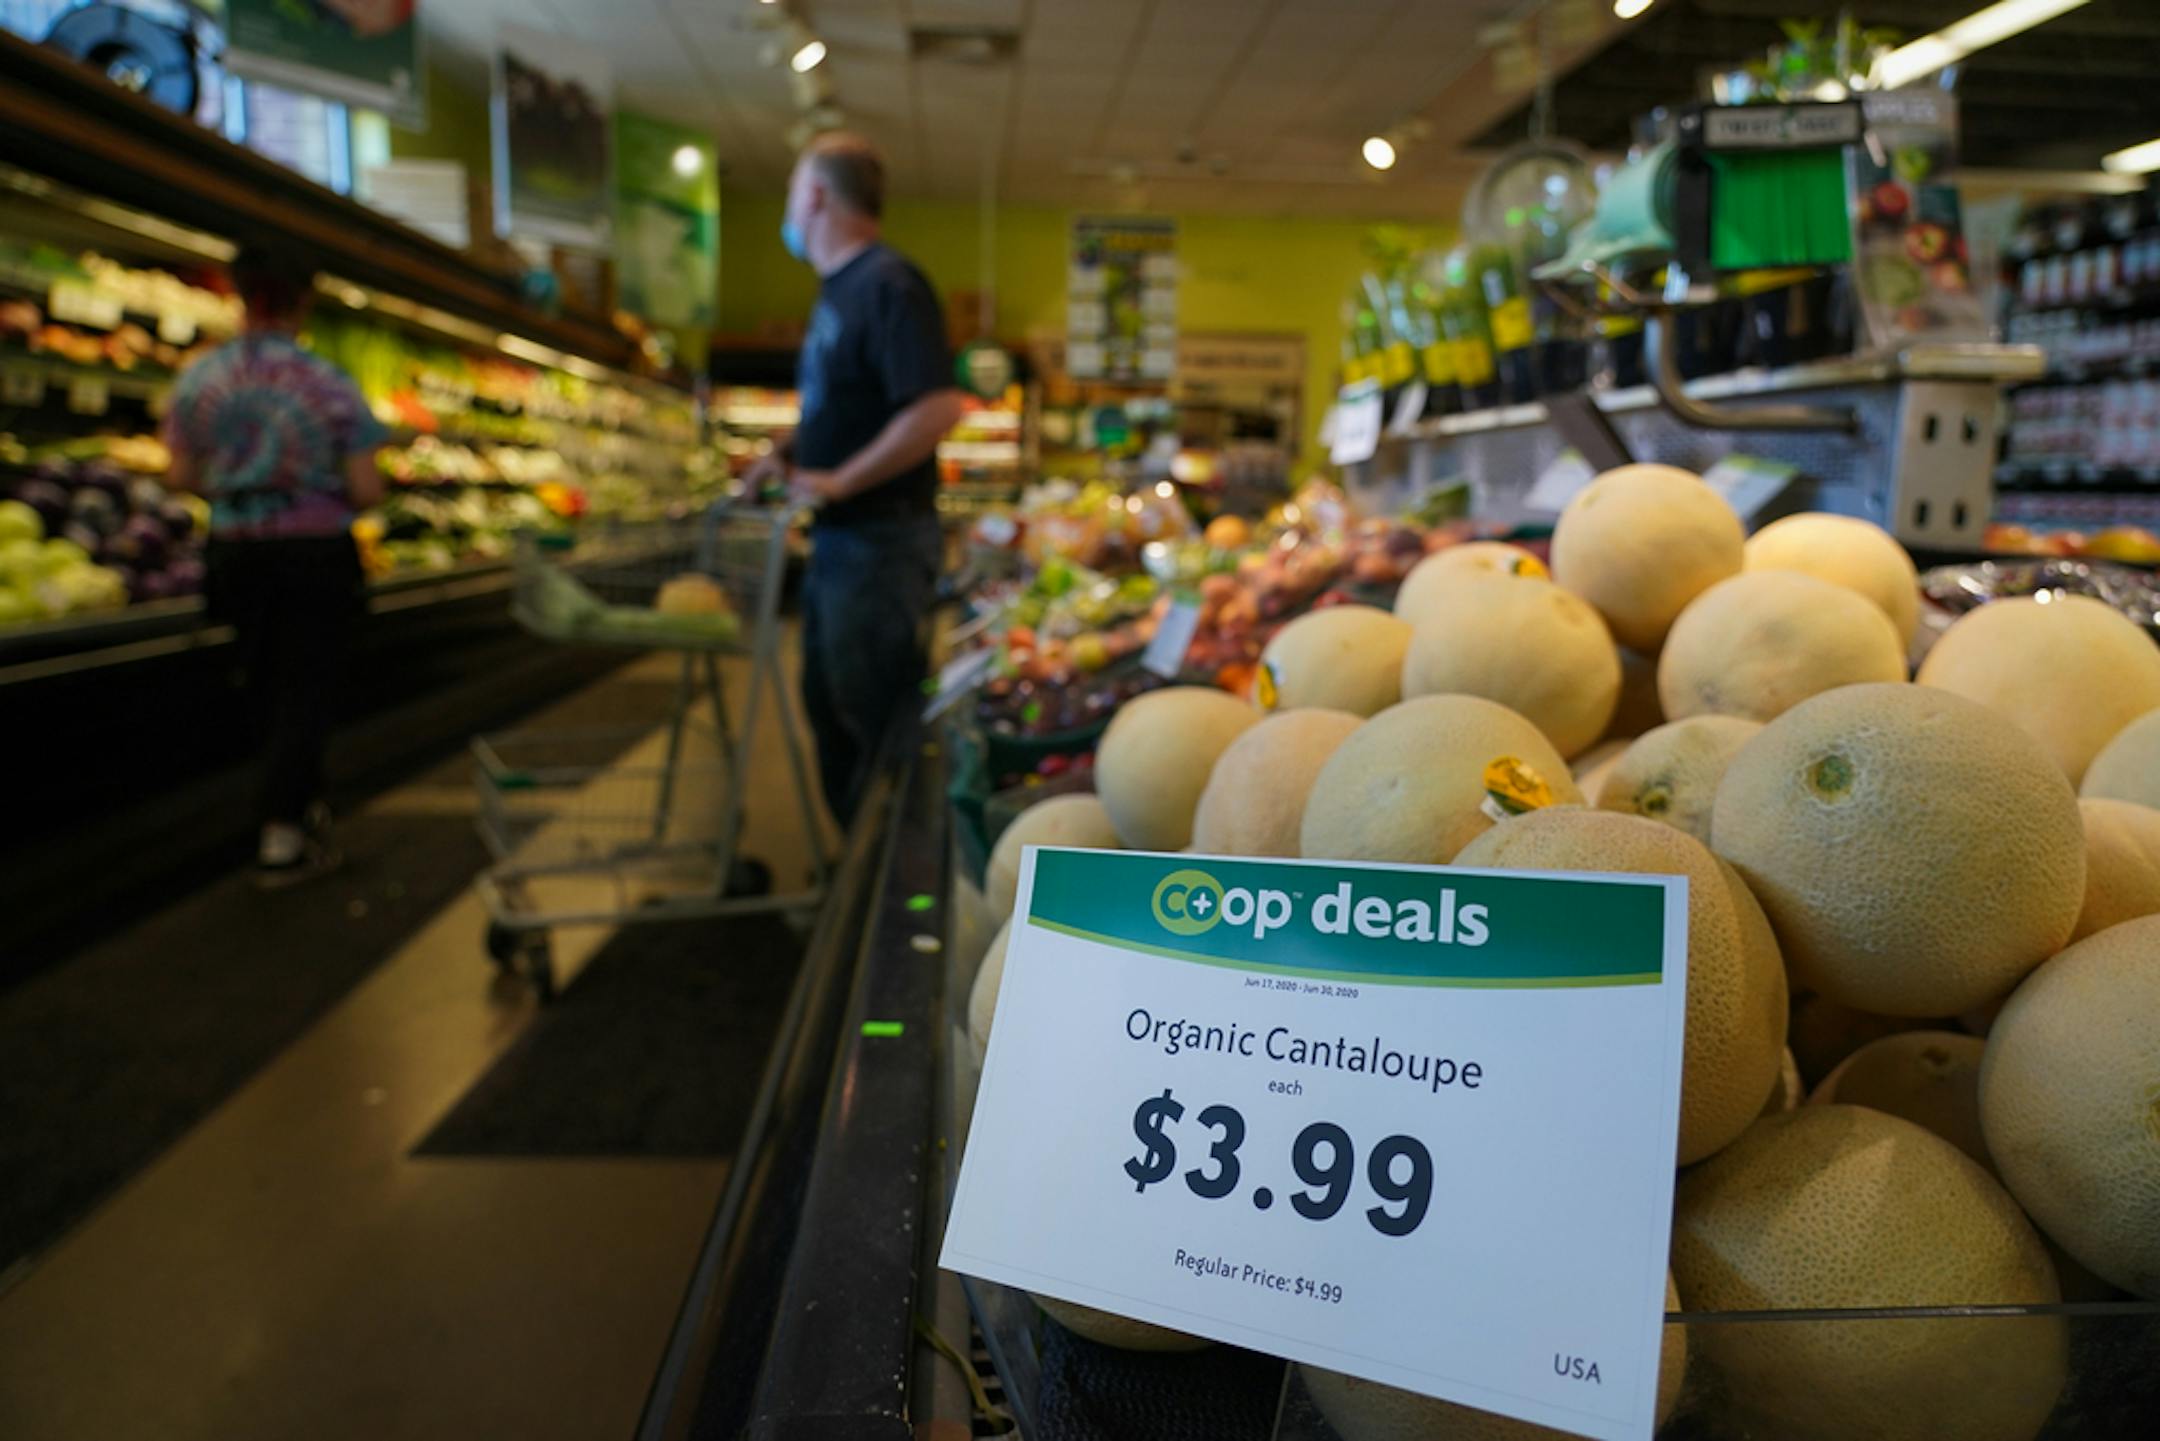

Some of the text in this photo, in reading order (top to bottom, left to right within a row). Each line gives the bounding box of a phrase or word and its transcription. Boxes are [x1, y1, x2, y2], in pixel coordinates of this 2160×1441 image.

[1311, 881, 1489, 946] deals
[1126, 1008, 1484, 1094] Organic Cantaloupe
[1267, 1079, 1303, 1096] each
[1122, 1087, 1435, 1238] $3.99
[1174, 1248, 1343, 1305] Regular Price: $4.99
[1554, 1353, 1602, 1385] USA
